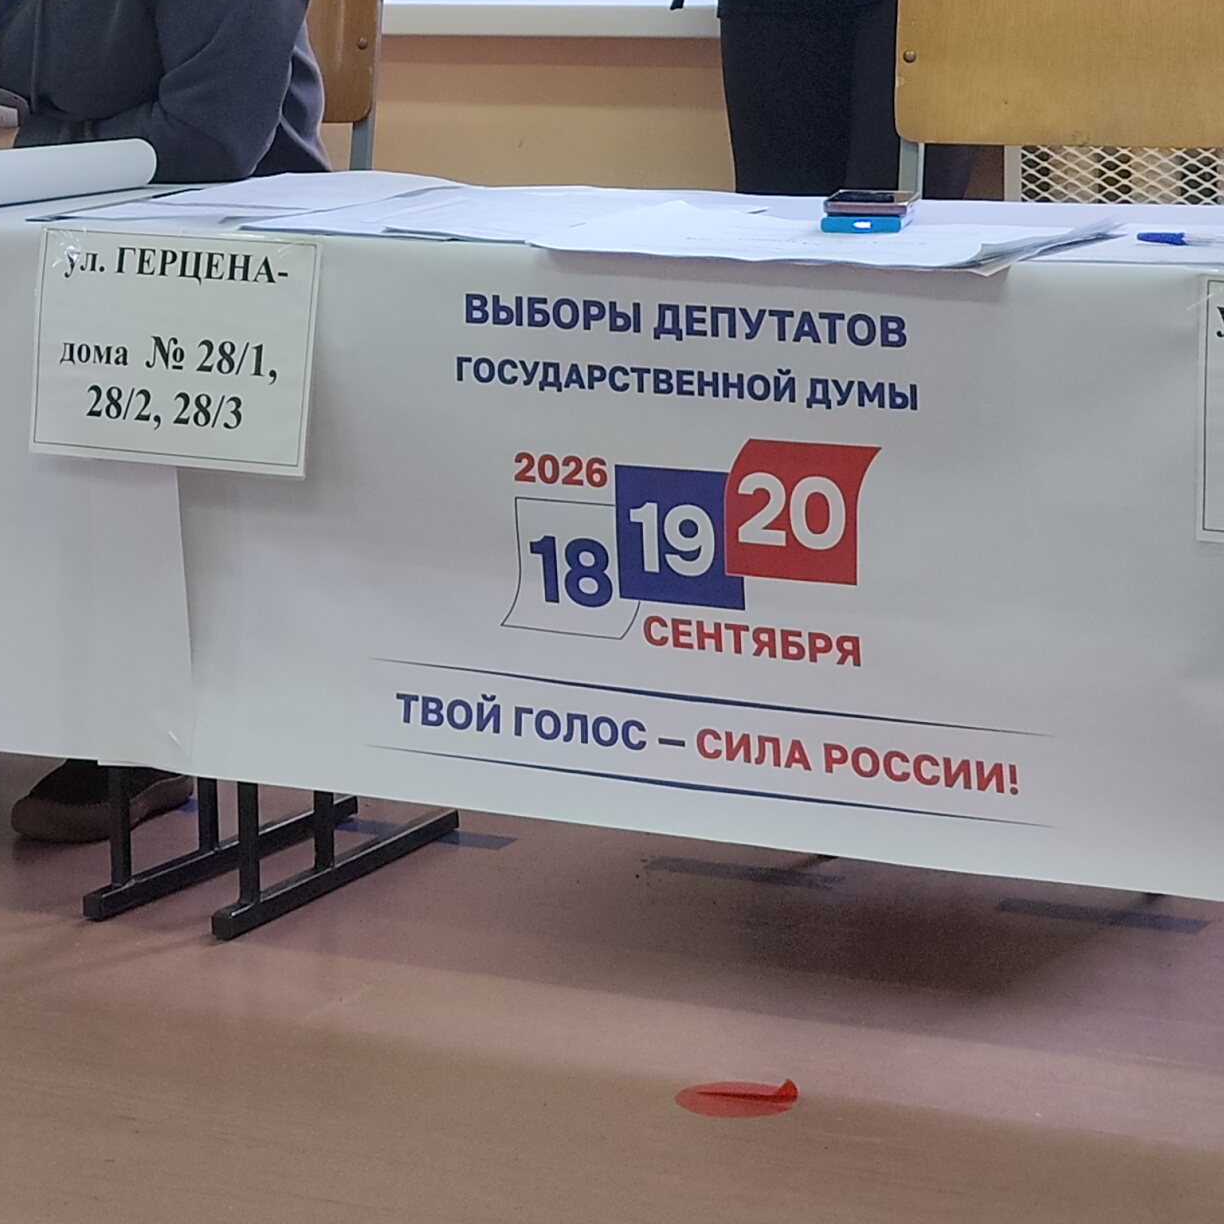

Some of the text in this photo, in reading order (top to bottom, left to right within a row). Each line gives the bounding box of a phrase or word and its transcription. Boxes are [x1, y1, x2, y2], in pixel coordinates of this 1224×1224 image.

[64, 249, 105, 278] ул.
[464, 292, 908, 348] ВЫБОРЫ ДЕПУТАТОВ
[59, 335, 279, 385] дома № 28/1,
[455, 355, 919, 411] ГОСУДАРСТВЕННОЙ ДУМЫ
[85, 384, 243, 430] 28/2, 28/3
[514, 452, 608, 488] 2026
[628, 502, 716, 578] 19
[736, 472, 846, 552] 20
[528, 534, 613, 608] 18
[642, 615, 862, 667] СЕНТЯБРЯ
[396, 692, 502, 735] ТВОЙ
[513, 704, 648, 753] ГОЛОС
[696, 726, 812, 771] СИЛА
[823, 743, 1020, 796] РОССИИ!
